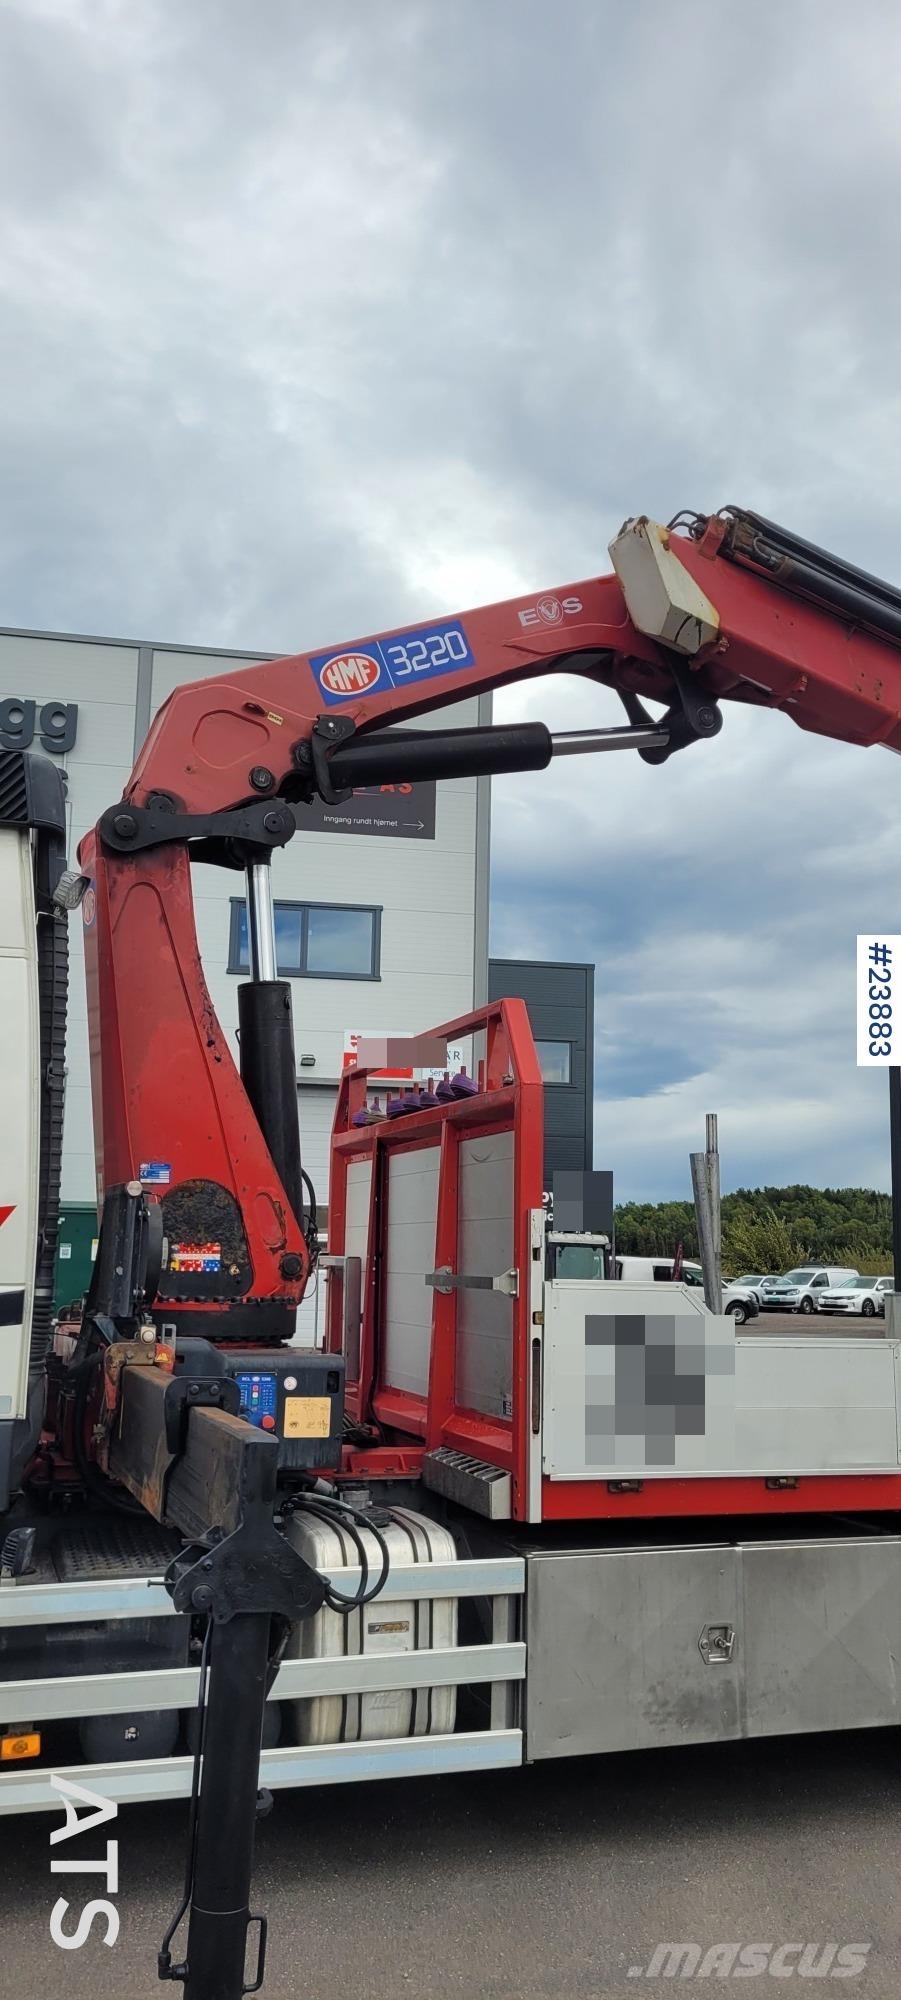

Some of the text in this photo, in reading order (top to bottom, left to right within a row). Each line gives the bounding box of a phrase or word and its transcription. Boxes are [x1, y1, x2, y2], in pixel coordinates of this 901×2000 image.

[326, 631, 468, 690] HMF 3220
[323, 815, 398, 827] Inngang rundt hjørnet
